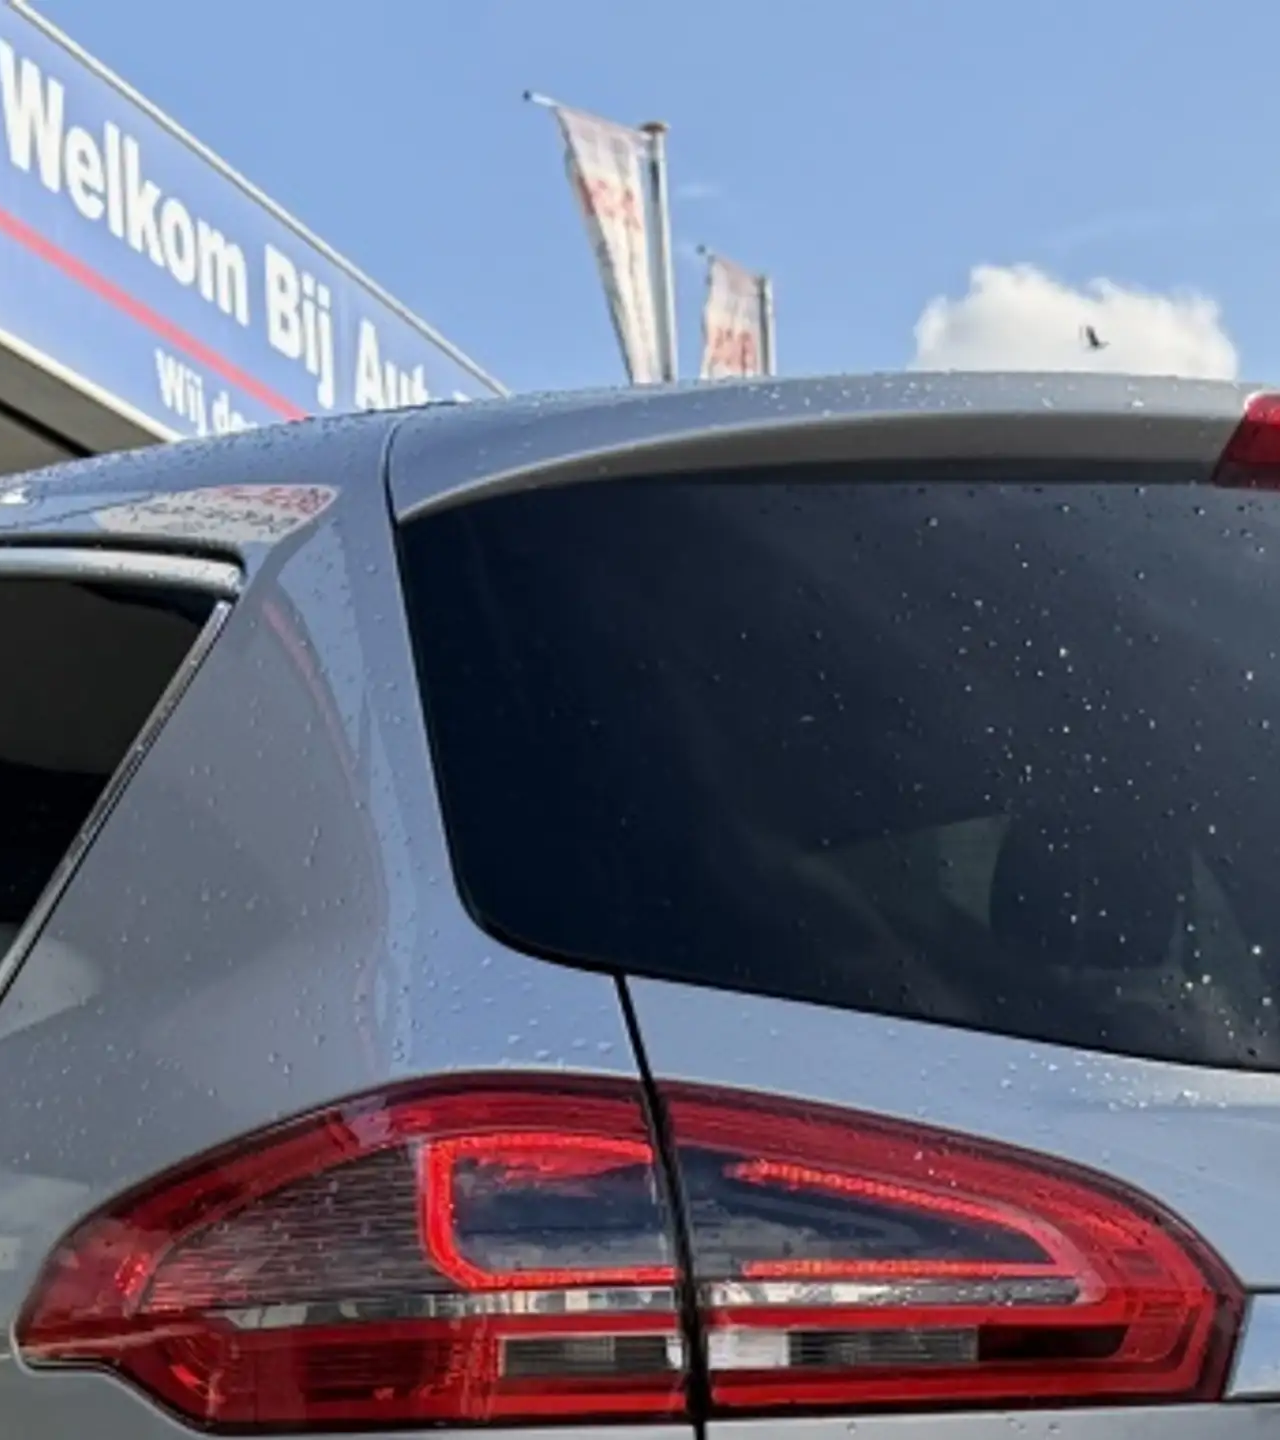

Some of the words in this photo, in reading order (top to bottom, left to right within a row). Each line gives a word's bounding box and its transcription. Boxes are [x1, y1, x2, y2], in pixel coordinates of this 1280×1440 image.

[154, 346, 207, 437] Wij
[264, 242, 334, 410] Bij
[354, 315, 444, 411] Aut
